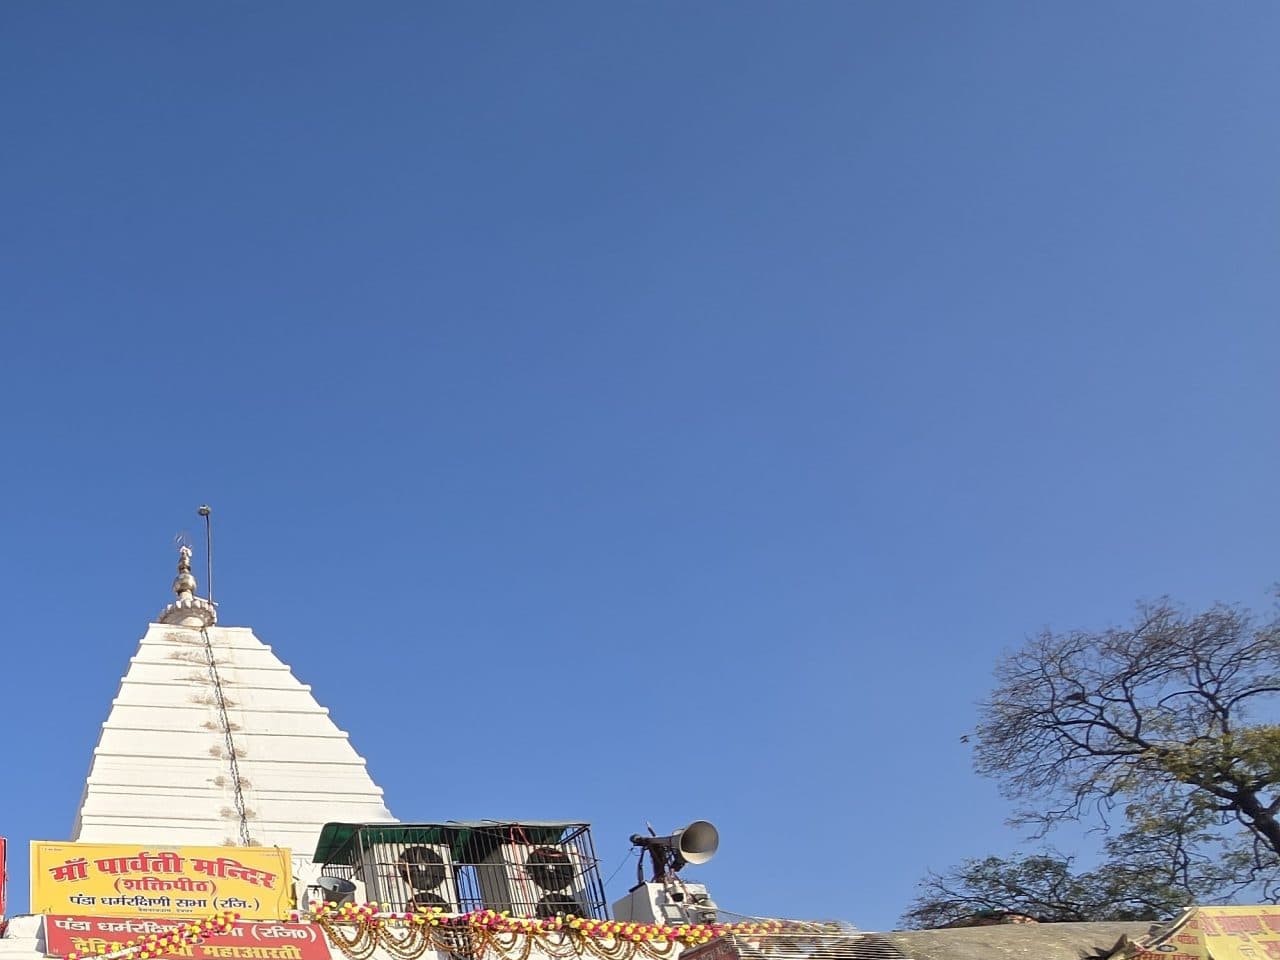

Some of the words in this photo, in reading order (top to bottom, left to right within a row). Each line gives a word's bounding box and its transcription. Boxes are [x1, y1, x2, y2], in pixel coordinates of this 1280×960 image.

[94, 852, 187, 876] पार्वती
[191, 857, 278, 889] मन्दिर
[113, 876, 217, 897] (शक्तिपीठ)
[70, 893, 95, 906] पंडा
[100, 894, 171, 908] धर्मरक्षिणी
[175, 898, 208, 908] सभा
[54, 917, 92, 932] पंडा
